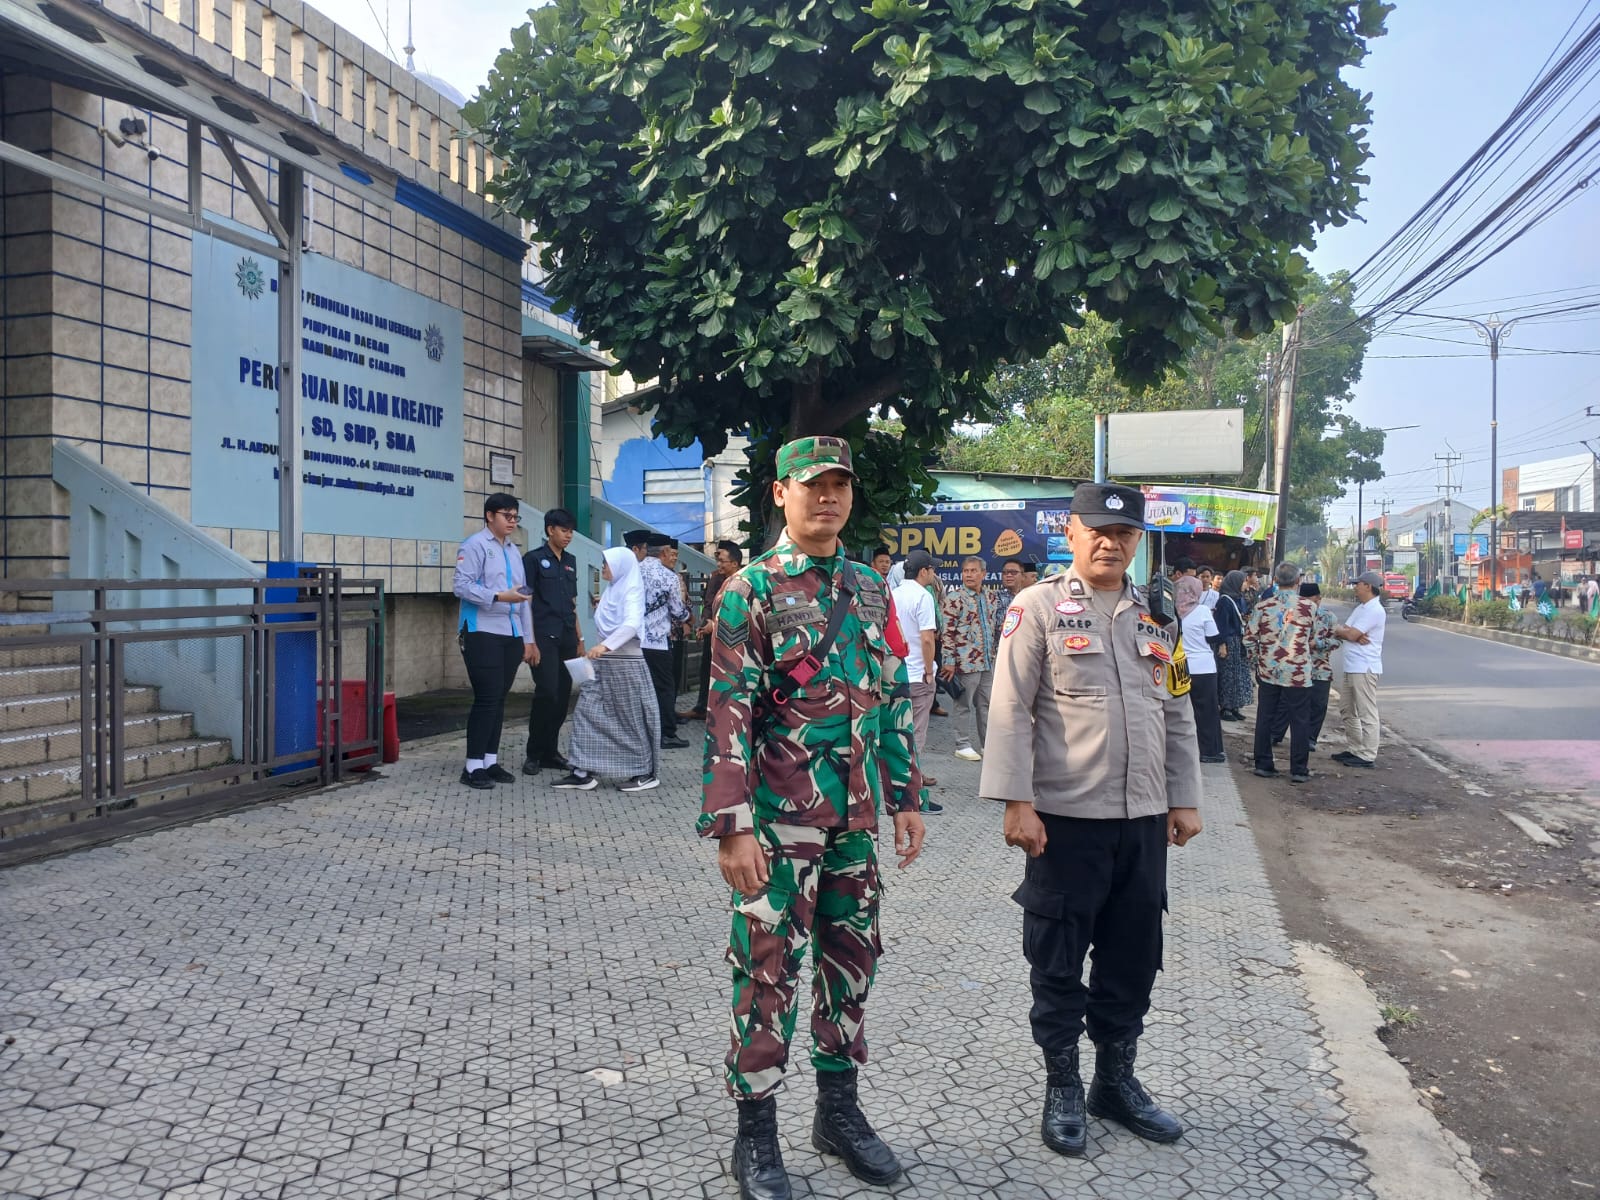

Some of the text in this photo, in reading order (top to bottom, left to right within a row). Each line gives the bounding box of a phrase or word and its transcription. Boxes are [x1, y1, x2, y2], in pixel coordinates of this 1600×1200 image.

[303, 317, 390, 355] PIMPINAN DAERAH
[369, 357, 406, 378] CIANJUR
[239, 357, 444, 428] PERRUAN ISLAM KREATIF
[312, 415, 337, 442] SD,
[344, 423, 379, 450] SMP,
[386, 430, 416, 454] SMA
[304, 449, 320, 463] BIN
[1147, 505, 1179, 519] JUARA
[879, 526, 982, 556] SPMB
[1057, 618, 1092, 629] ACEP
[1137, 622, 1170, 643] POLRI
